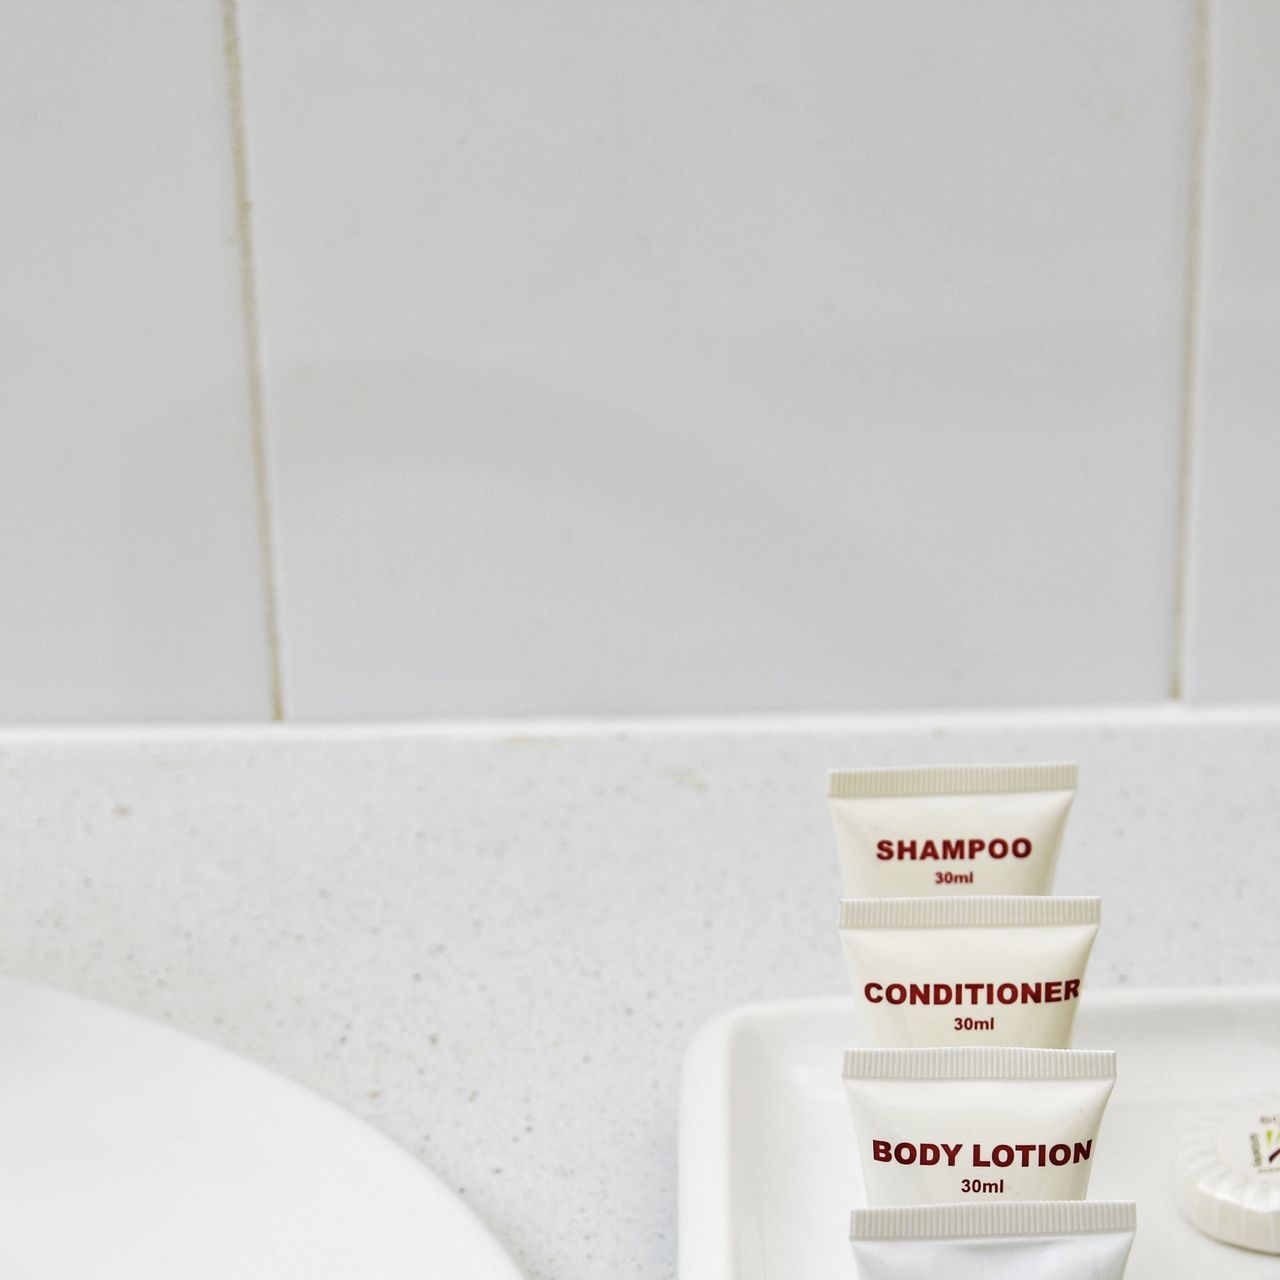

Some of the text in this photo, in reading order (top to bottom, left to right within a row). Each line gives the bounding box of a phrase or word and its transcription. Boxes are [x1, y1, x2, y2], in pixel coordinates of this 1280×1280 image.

[876, 837, 1033, 861] SHAMPOO
[935, 871, 974, 885] 30ml
[863, 978, 1081, 1006] CONDITIONER
[953, 1016, 995, 1031] 30ml
[872, 1138, 1093, 1168] BODY LOTION
[960, 1178, 1005, 1194] 30ml
